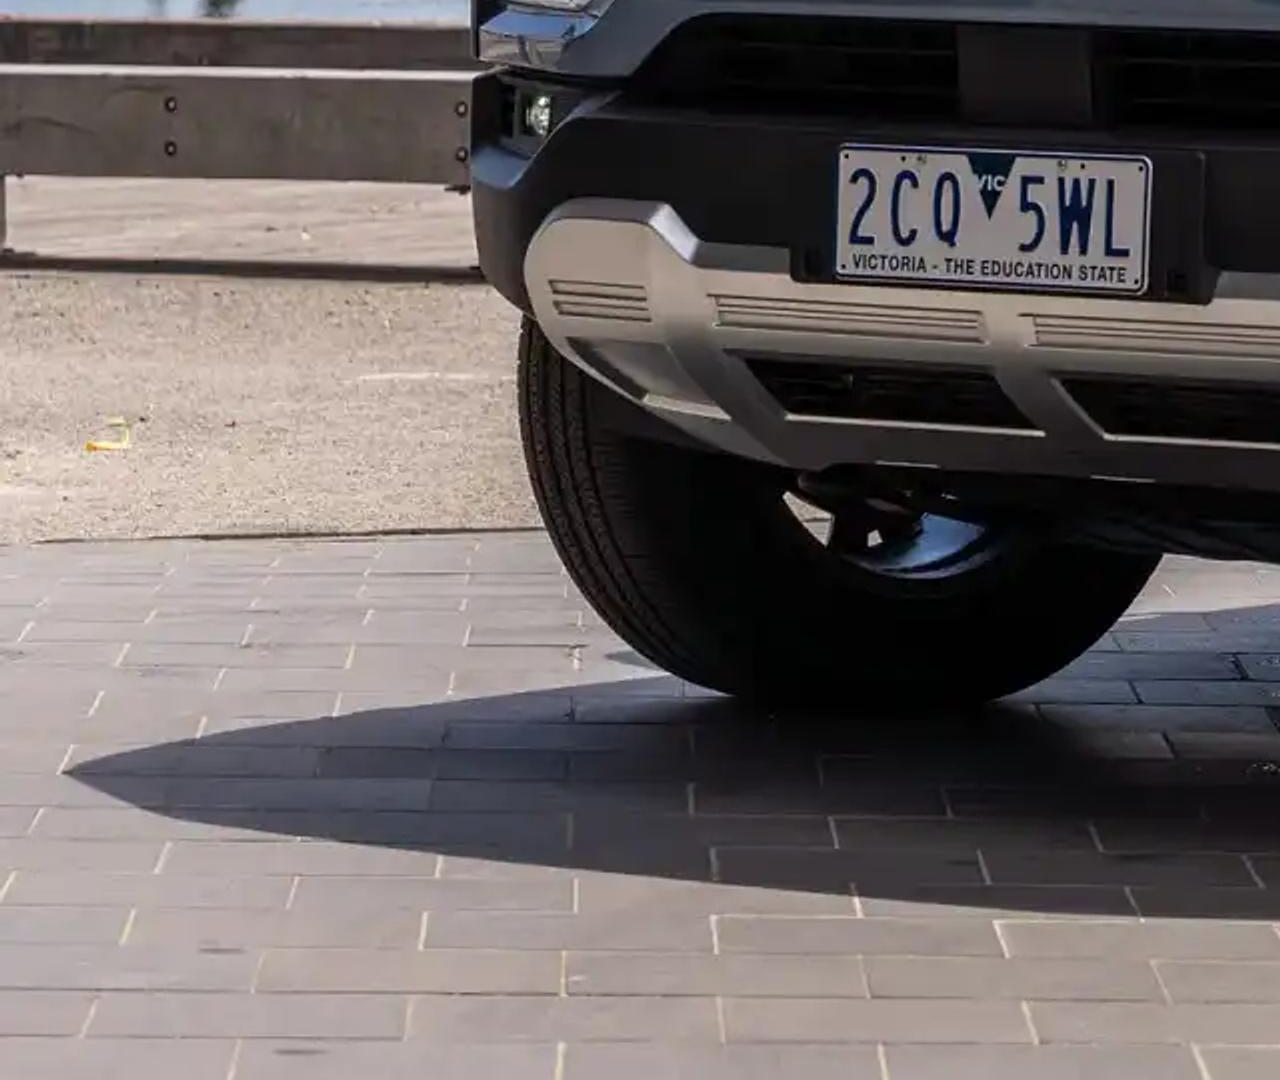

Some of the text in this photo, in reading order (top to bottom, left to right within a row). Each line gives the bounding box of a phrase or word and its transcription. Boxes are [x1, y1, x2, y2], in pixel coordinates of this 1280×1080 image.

[976, 173, 1008, 192] VIC
[847, 168, 1131, 258] 2CQ 5WL
[851, 253, 928, 274] VICTORIA
[943, 257, 976, 276] THE
[979, 259, 1073, 280] EDUCATION
[1077, 264, 1127, 284] STATE
